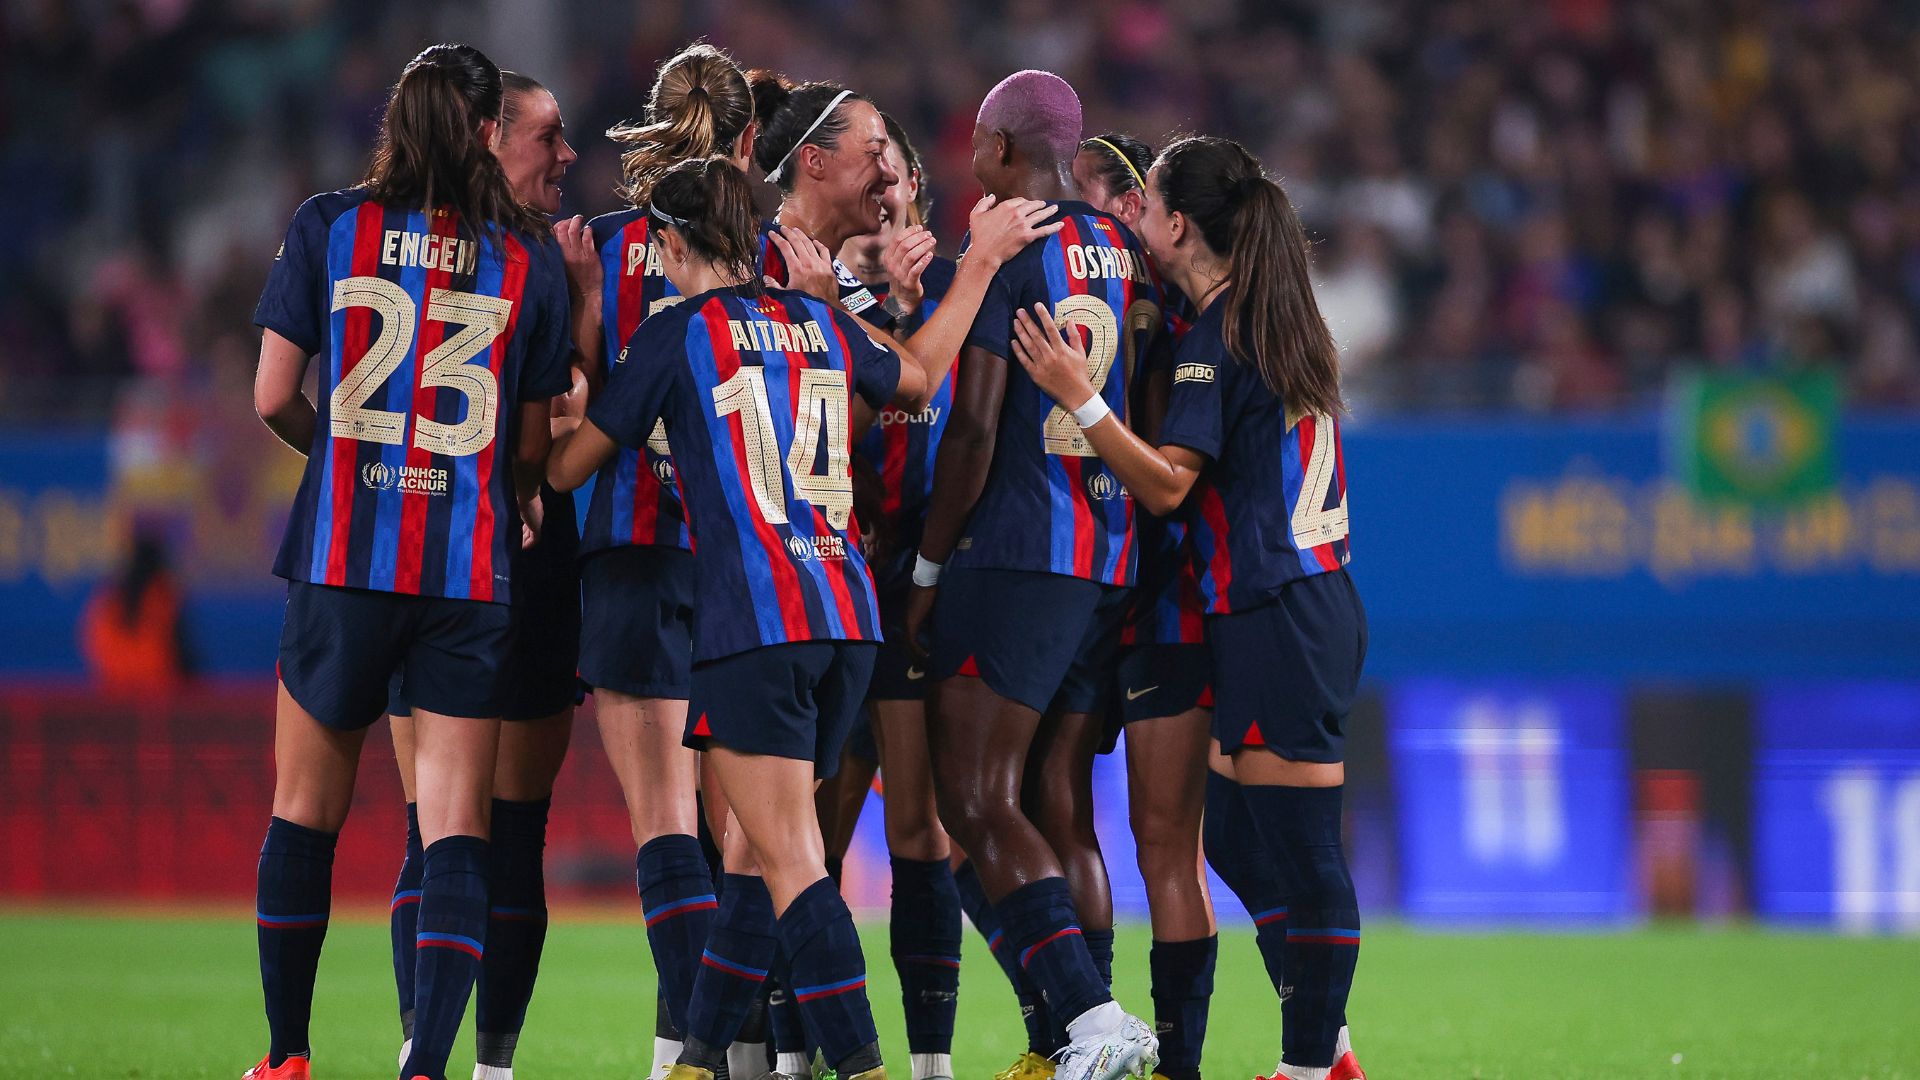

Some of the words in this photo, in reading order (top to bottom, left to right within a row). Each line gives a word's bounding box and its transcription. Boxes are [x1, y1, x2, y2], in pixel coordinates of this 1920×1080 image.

[727, 320, 829, 352] AITANA
[331, 276, 513, 456] 23
[1174, 366, 1215, 381] BIMBO
[712, 365, 854, 531] 14
[396, 478, 446, 491] ACNUR
[398, 466, 447, 480] UNHCR
